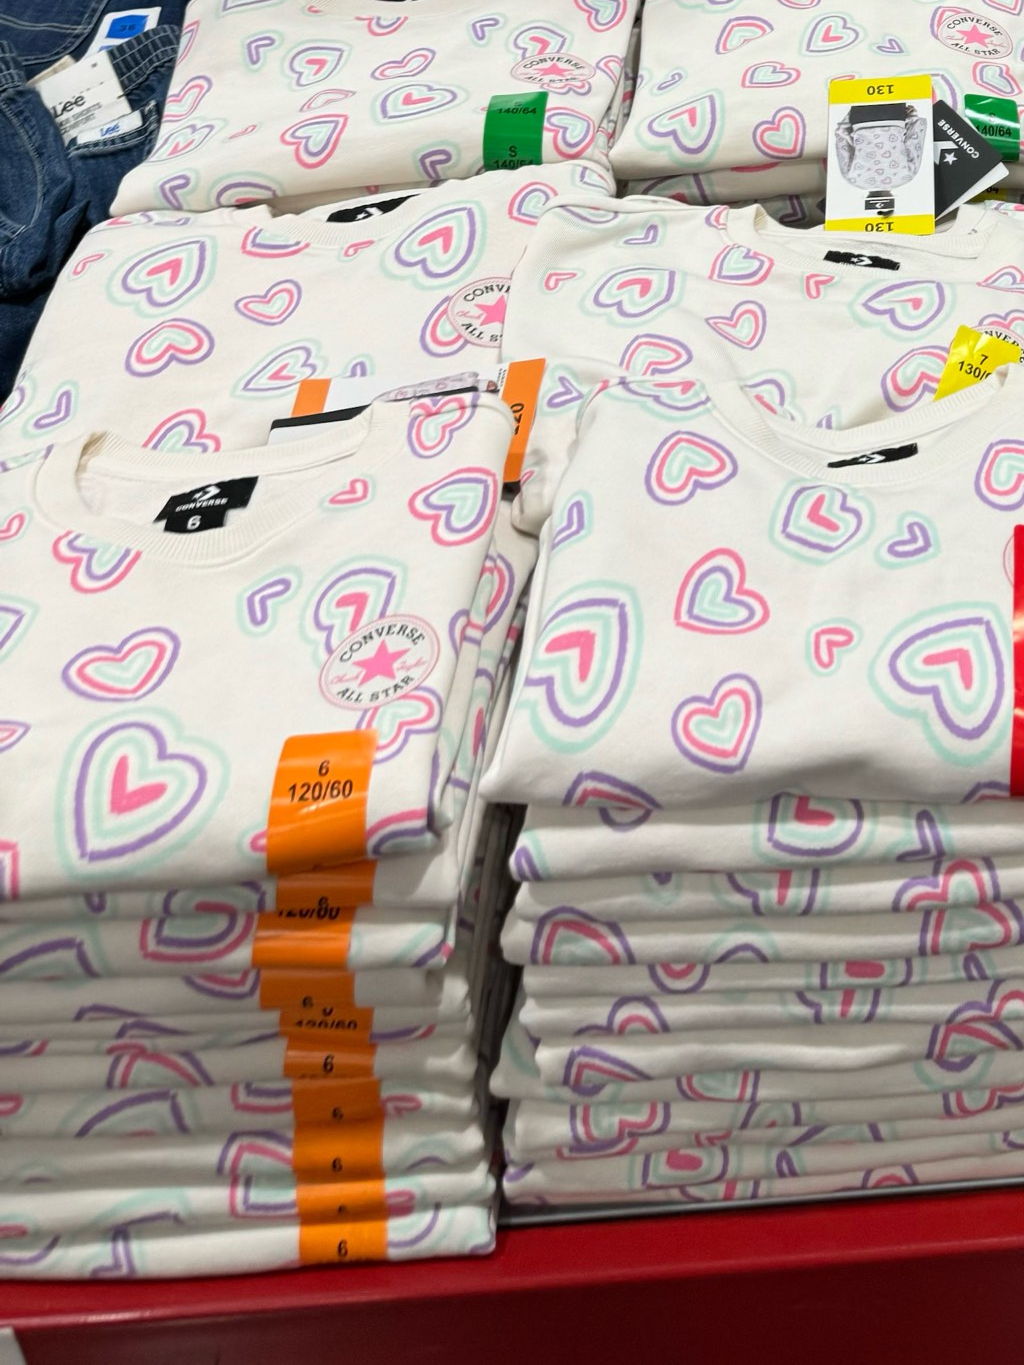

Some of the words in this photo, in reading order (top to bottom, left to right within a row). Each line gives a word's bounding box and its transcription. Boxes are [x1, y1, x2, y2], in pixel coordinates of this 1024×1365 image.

[946, 15, 1004, 37] CONVERSE
[523, 55, 586, 71] CONVERSE
[866, 83, 895, 96] 130
[50, 94, 87, 118] Lee
[937, 119, 981, 160] CONVERSE
[508, 145, 519, 158] S
[864, 221, 895, 233] 130
[979, 354, 989, 366] 7
[175, 495, 228, 513] CONVERSE
[187, 515, 201, 530] 6
[339, 623, 426, 664] CONVERSE
[336, 687, 363, 704] ALL
[369, 675, 416, 703] STAR
[318, 759, 330, 777] 6
[288, 780, 354, 803] 120/60
[322, 1054, 335, 1073] 6
[331, 1158, 342, 1172] 6
[337, 1239, 348, 1257] 6
